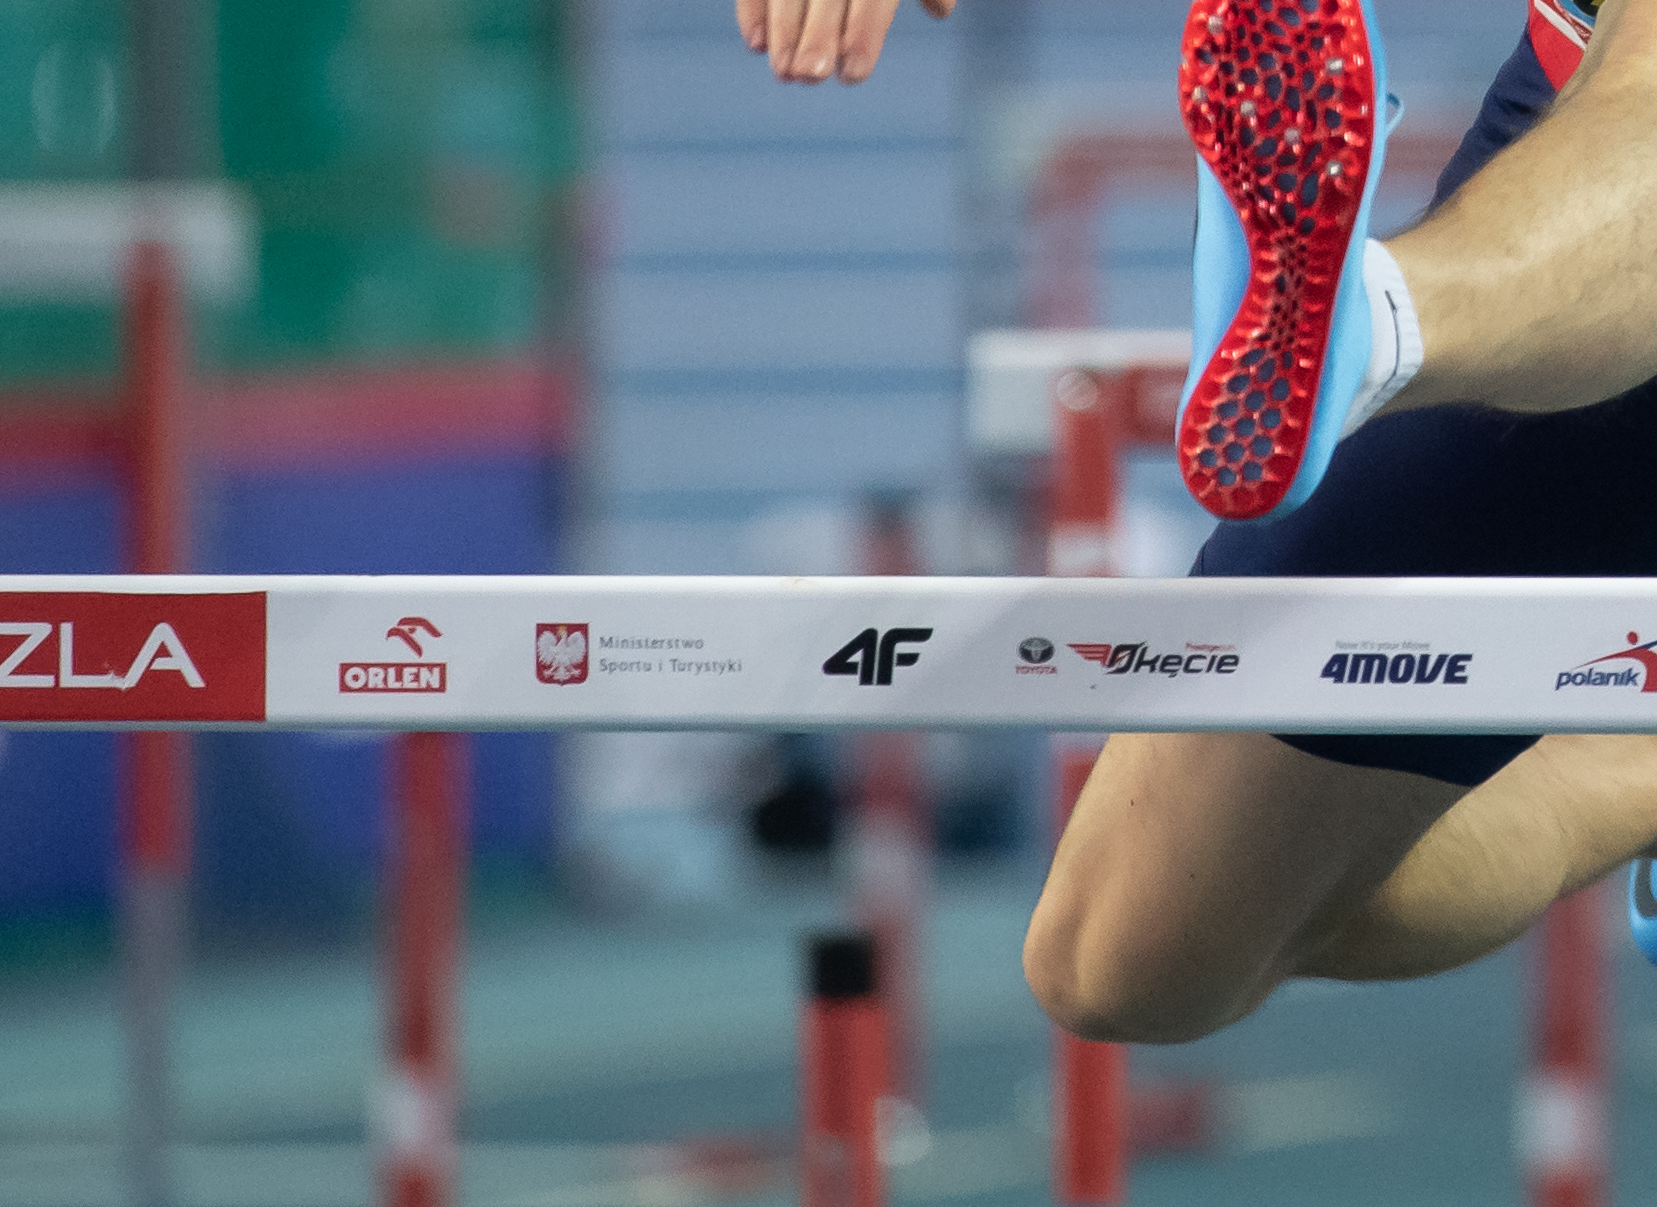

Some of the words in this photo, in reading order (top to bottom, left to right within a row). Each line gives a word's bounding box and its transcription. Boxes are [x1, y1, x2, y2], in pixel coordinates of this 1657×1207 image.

[599, 636, 704, 650] Ministerstwo
[599, 658, 652, 675] Sportu
[669, 658, 742, 675] Turystyki
[823, 627, 934, 686] 4F
[1320, 653, 1474, 684] 4MOVE
[344, 666, 441, 690] ORLEN
[1554, 667, 1642, 691] polanik
